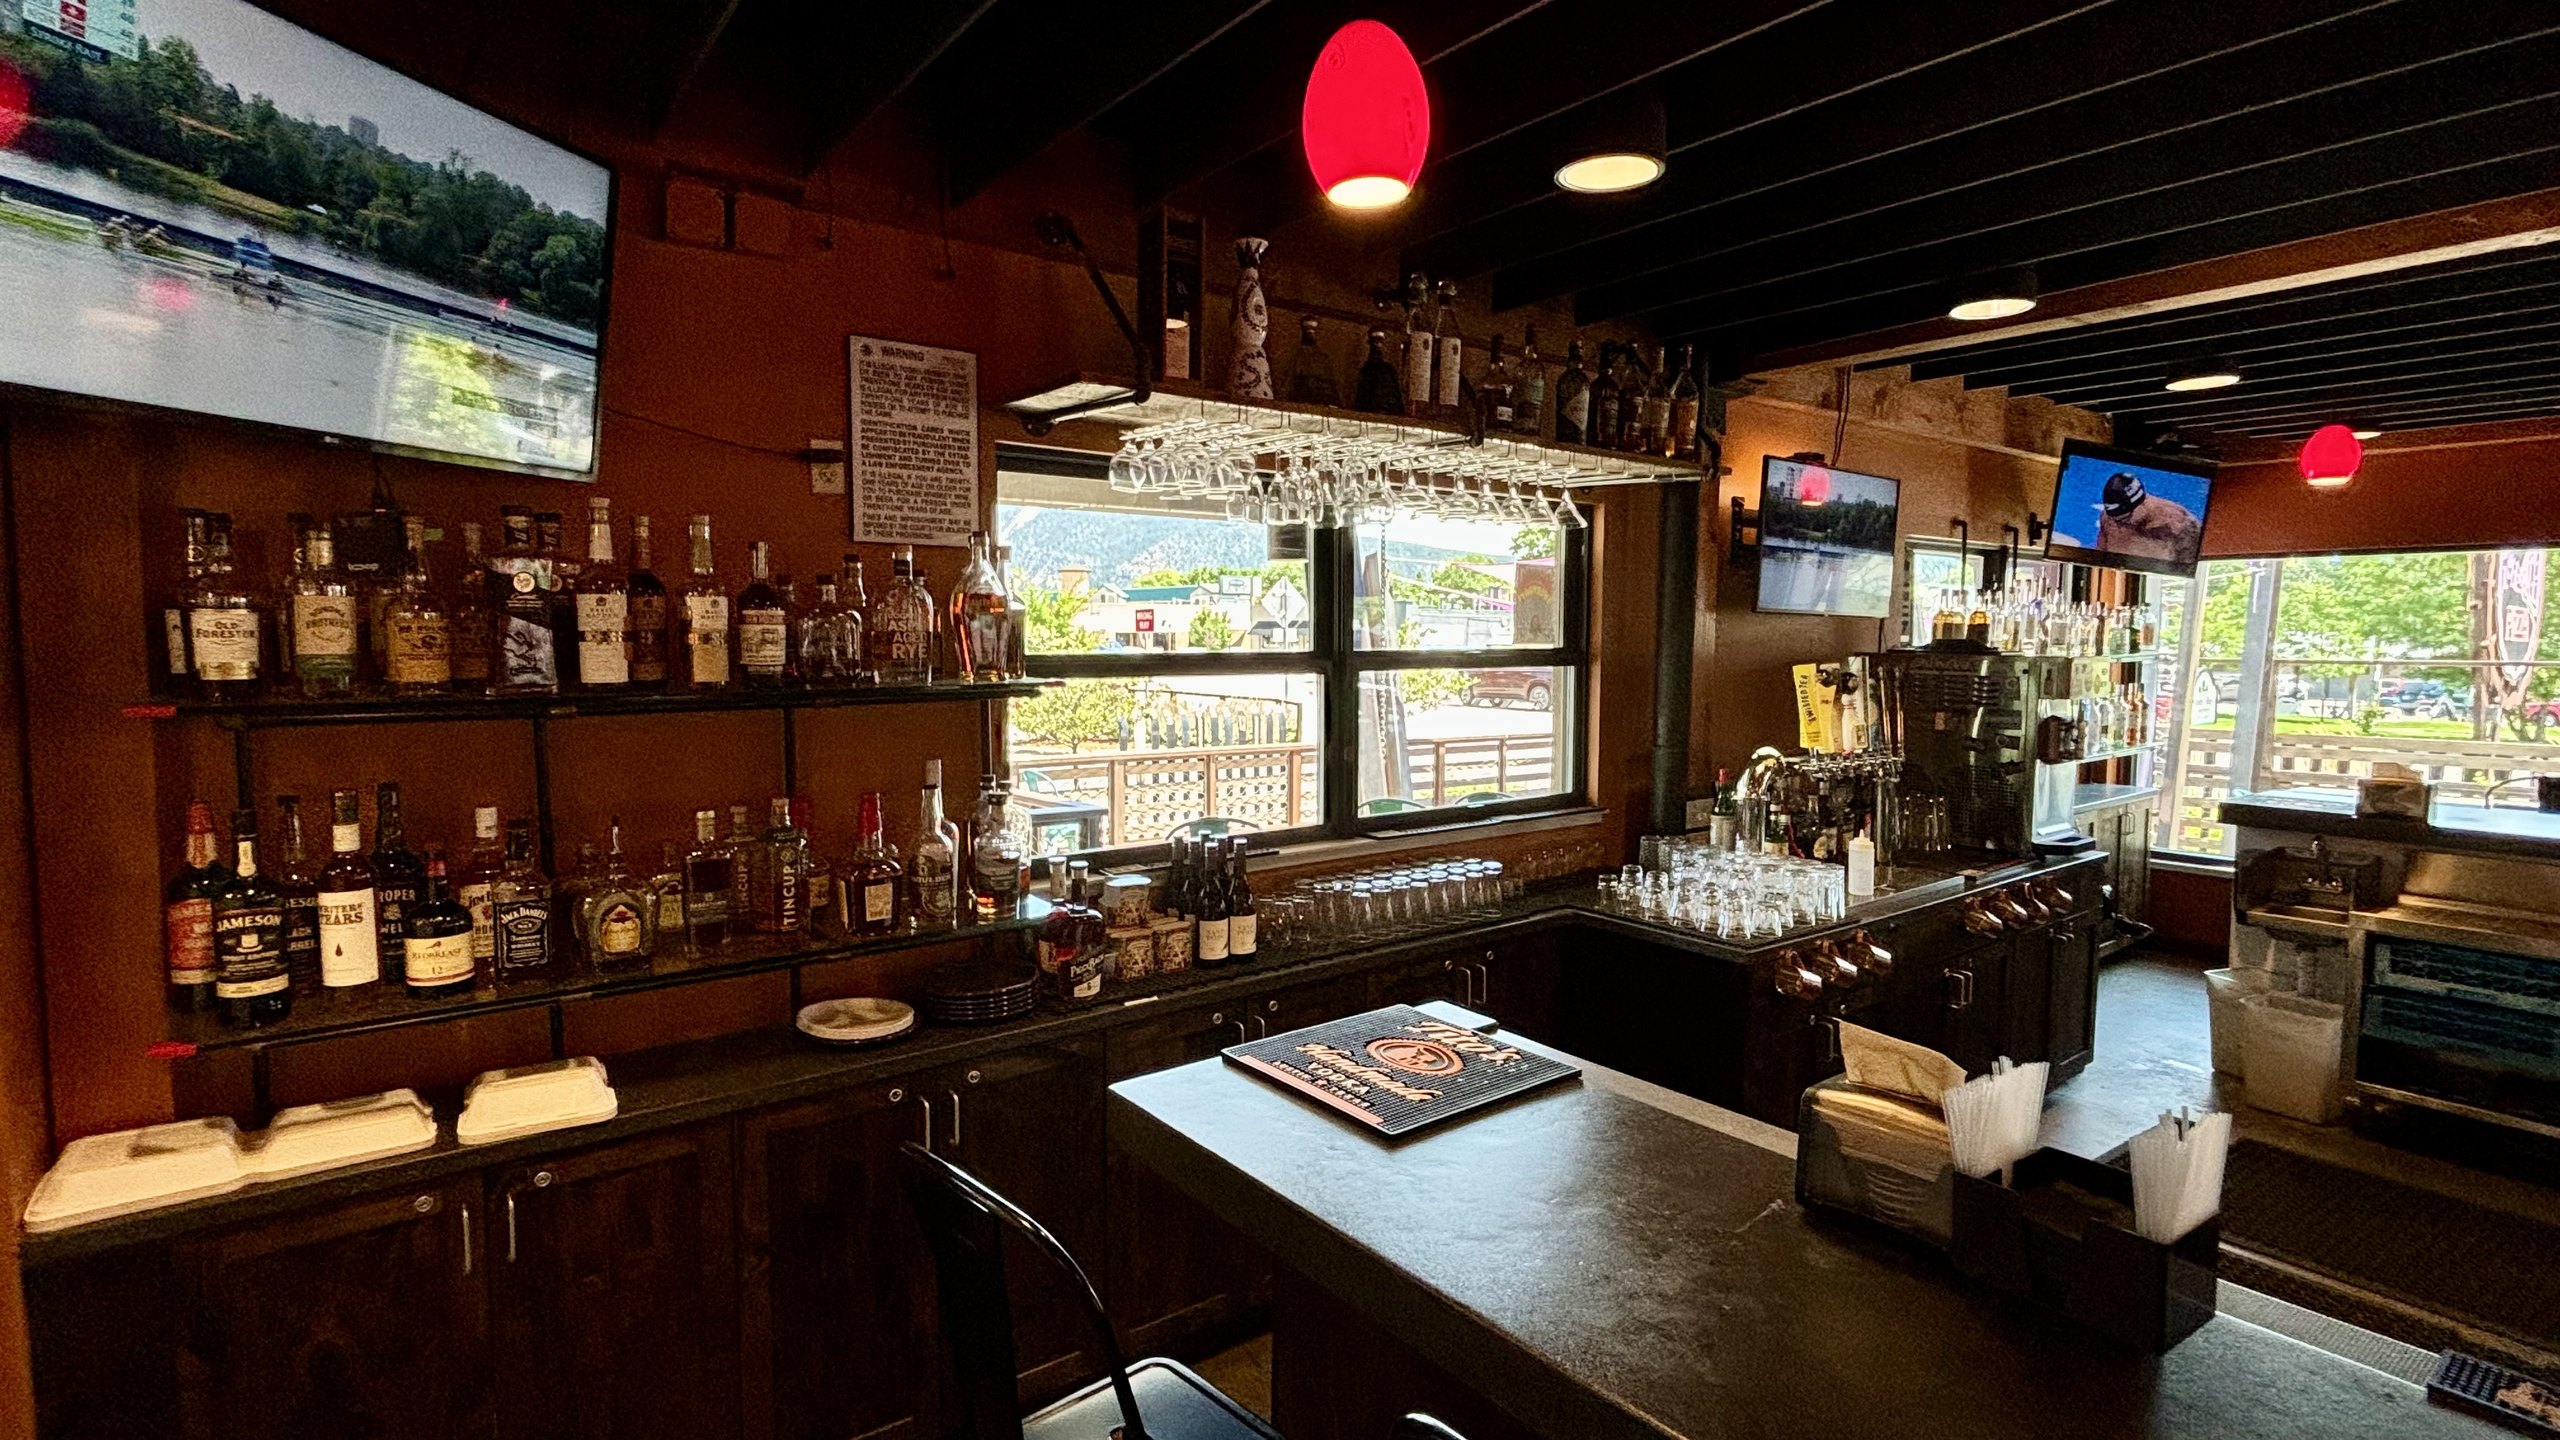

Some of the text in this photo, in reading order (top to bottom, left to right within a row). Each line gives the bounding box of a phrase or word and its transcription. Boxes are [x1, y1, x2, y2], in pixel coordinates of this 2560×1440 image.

[880, 345, 924, 361] WARNING
[872, 444, 919, 455] CONFISCATED
[948, 451, 969, 459] ESTAB-
[214, 621, 238, 630] OLD
[196, 629, 256, 638] FORESTER
[892, 643, 928, 658] RYE
[380, 889, 416, 902] ROPER
[783, 865, 796, 926] TINCUP
[217, 914, 282, 932] JAMESON
[432, 966, 443, 974] 12
[1404, 1021, 1522, 1065] Tito's
[1296, 1042, 1444, 1101] Handmade
[1307, 1062, 1371, 1095] VODKA
